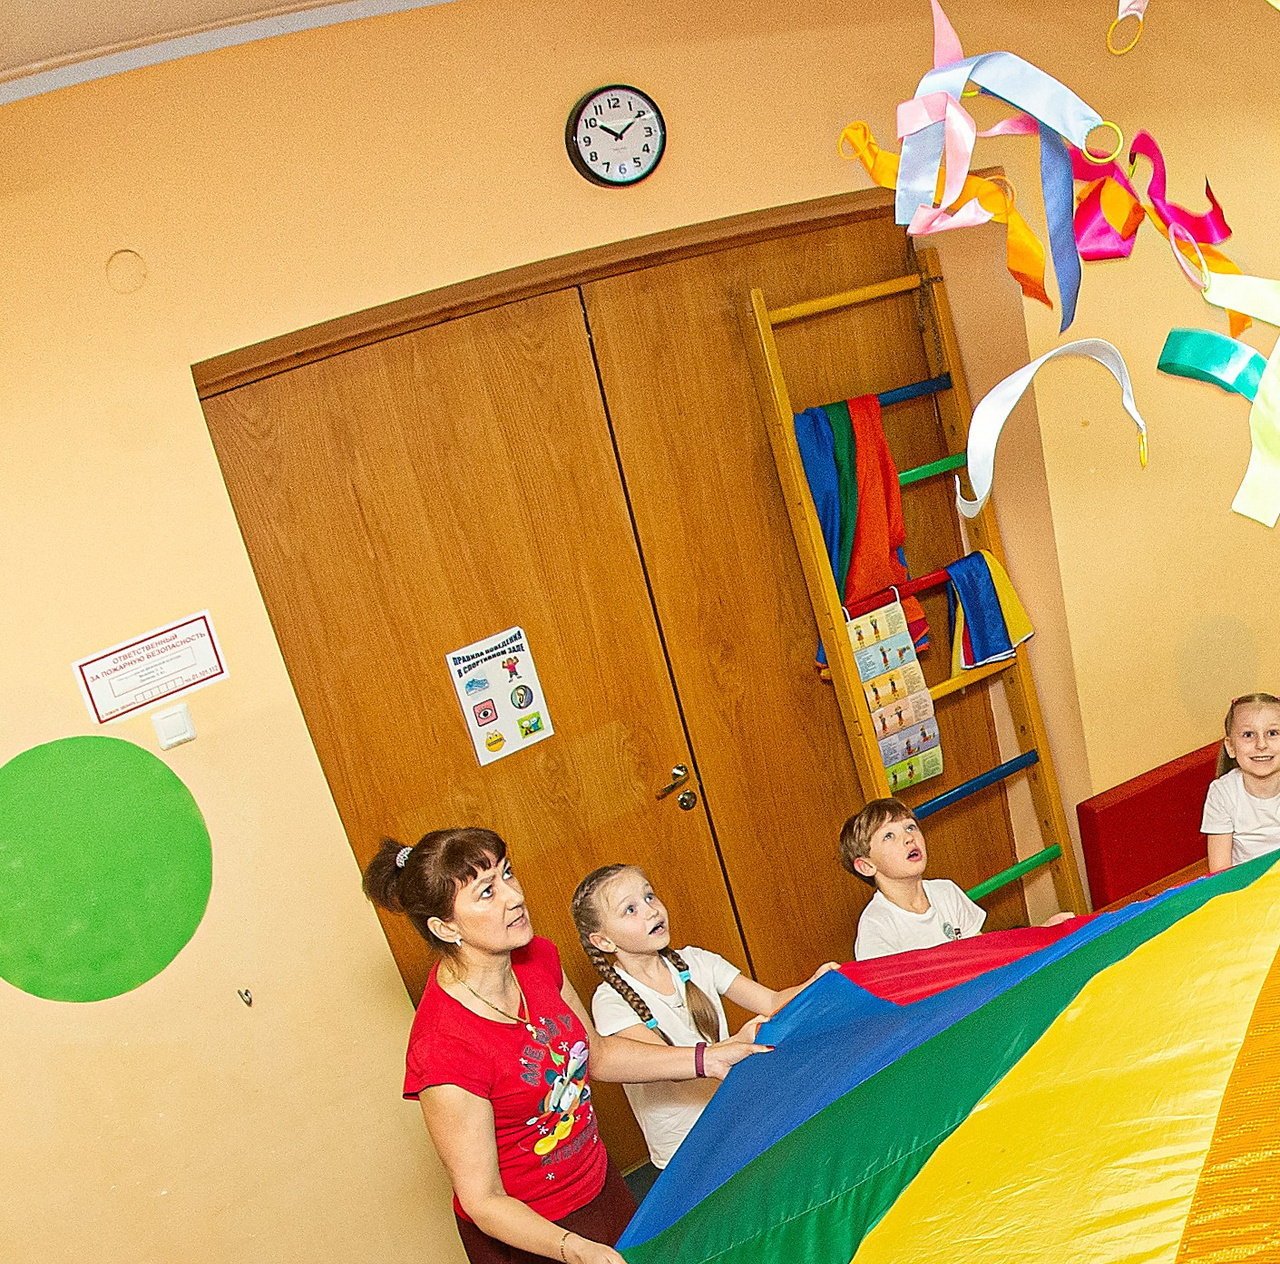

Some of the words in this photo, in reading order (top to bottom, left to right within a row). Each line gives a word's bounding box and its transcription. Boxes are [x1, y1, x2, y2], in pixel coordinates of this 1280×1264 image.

[607, 97, 620, 109] 12
[627, 101, 633, 111] 1
[594, 104, 603, 116] 11
[584, 117, 598, 129] 10
[644, 126, 653, 137] 3
[582, 135, 592, 147] 9
[642, 143, 650, 154] 4
[589, 151, 598, 162] 8
[632, 157, 642, 167] 5
[602, 162, 611, 173] 7
[618, 164, 627, 174] 6
[112, 633, 178, 665] ОТВЕТСТВЕННЫЙ
[452, 651, 485, 666] ПРАВИЛА
[485, 630, 523, 654] ПОВЕДЕНИЯ
[89, 674, 101, 683] ЗА
[101, 655, 145, 678] ПОЖАРНУЮ
[146, 632, 206, 660] БЕЗОПАСНОСТЬ
[456, 668, 464, 678] В
[463, 649, 507, 674] СПОРТИВНОМ
[508, 643, 525, 654] ЗАЛЕ
